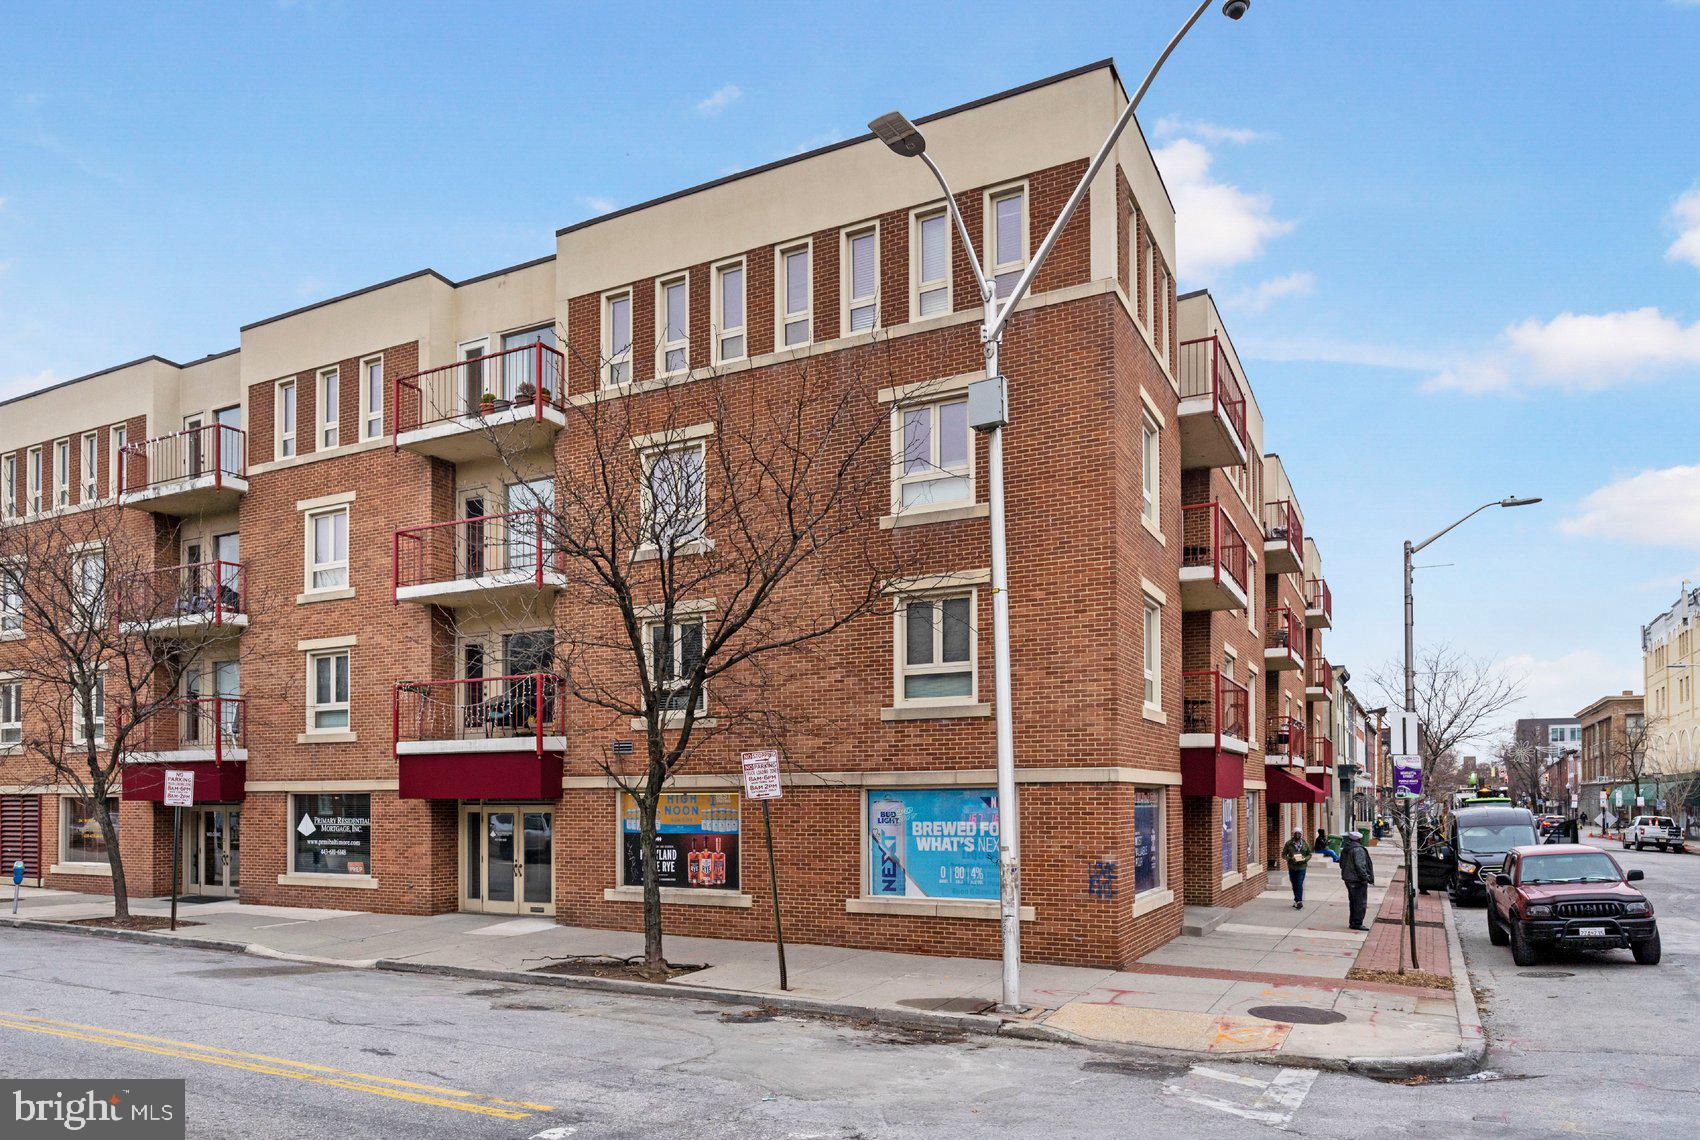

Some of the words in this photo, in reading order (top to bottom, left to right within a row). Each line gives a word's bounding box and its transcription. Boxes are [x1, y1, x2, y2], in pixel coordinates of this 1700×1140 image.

[752, 751, 777, 759] STOPPING
[753, 761, 777, 769] PARKING
[666, 795, 697, 804] HIGH
[664, 805, 699, 816] NOON
[912, 821, 977, 836] BREWED
[979, 821, 1000, 836] FO
[916, 837, 975, 852] WHAT'S
[977, 837, 1000, 853] NEX
[662, 861, 675, 873] RYE
[940, 865, 946, 879] 0
[970, 866, 984, 880] 4%
